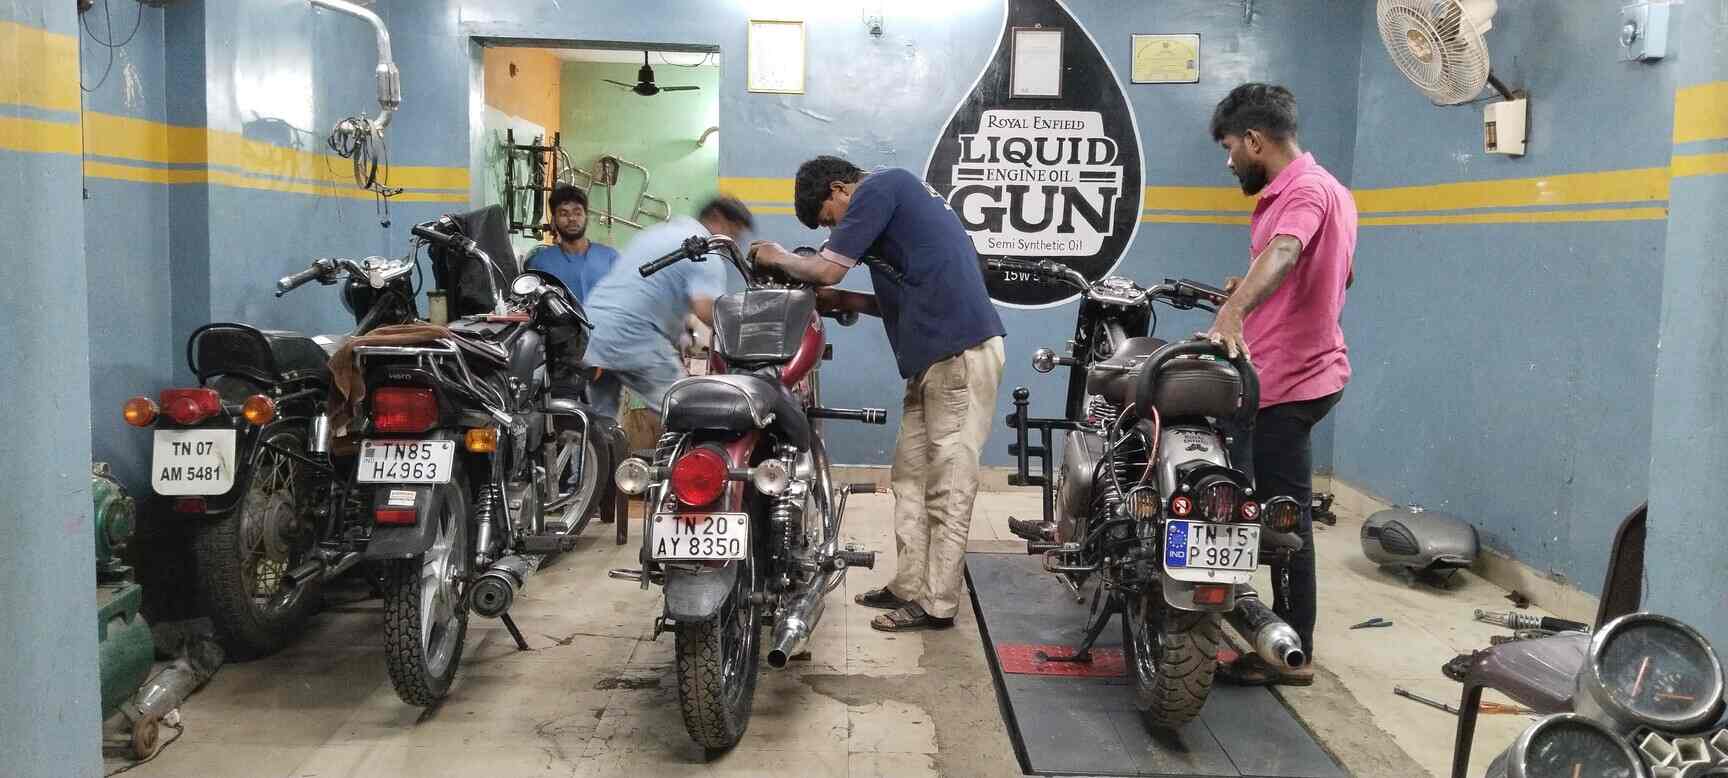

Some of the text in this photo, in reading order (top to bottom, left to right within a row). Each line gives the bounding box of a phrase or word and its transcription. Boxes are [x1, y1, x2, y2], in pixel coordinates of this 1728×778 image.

[959, 136, 1117, 167] LIQUID
[987, 169, 1073, 183] ENGINE OIL
[950, 185, 1118, 233] GUN
[988, 238, 1083, 251] Semi Synthetic Oil
[172, 441, 213, 456] TN 07
[384, 443, 432, 460] TN85
[160, 466, 221, 481] AM 5481
[373, 461, 437, 479] H4963
[672, 516, 728, 535] TN 20
[1193, 525, 1249, 546] TN 15
[657, 537, 740, 556] AY 8350
[1169, 550, 1185, 558] IND
[1190, 547, 1254, 568] P 9871
